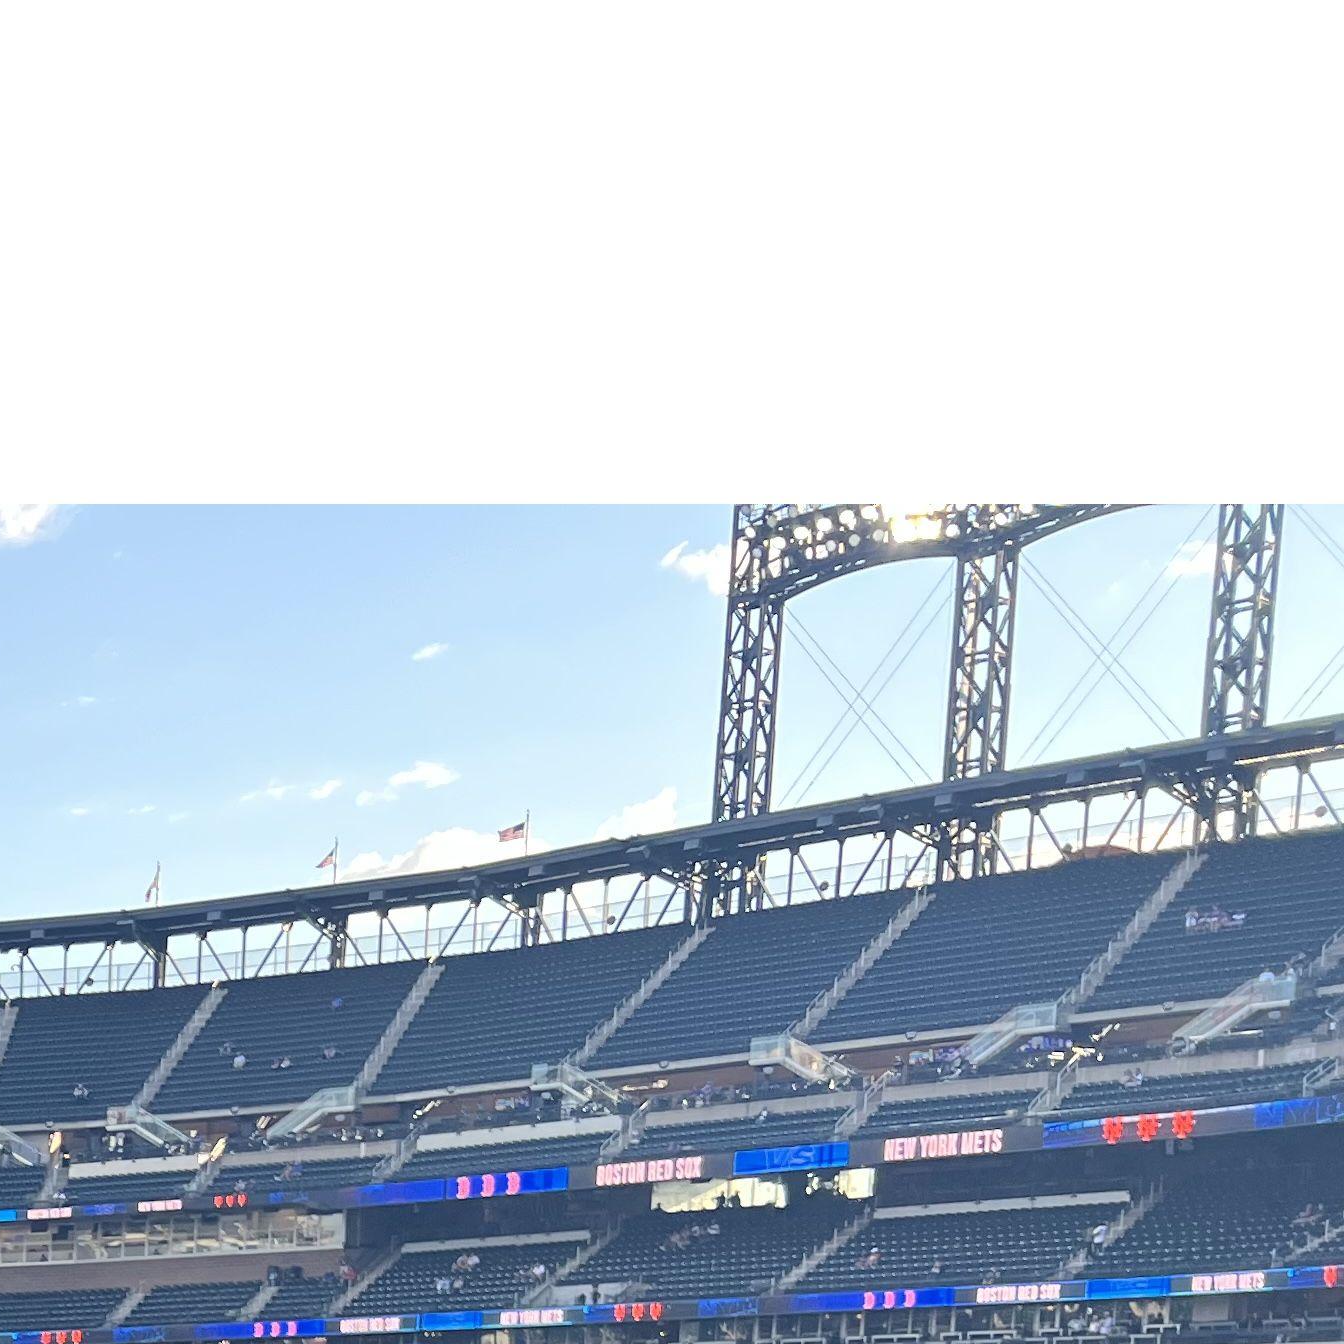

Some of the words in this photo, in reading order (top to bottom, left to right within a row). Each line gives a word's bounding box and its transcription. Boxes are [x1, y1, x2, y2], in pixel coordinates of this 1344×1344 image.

[884, 1136, 919, 1161] NEW
[919, 1132, 959, 1157] YORK
[960, 1128, 1003, 1155] METS
[595, 1161, 645, 1186] BOSTON
[647, 1158, 673, 1182] RED
[676, 1155, 703, 1179] SOX
[976, 1286, 1016, 1304] BOSTON
[1018, 1285, 1038, 1301] RED
[1039, 1283, 1061, 1299] SOX
